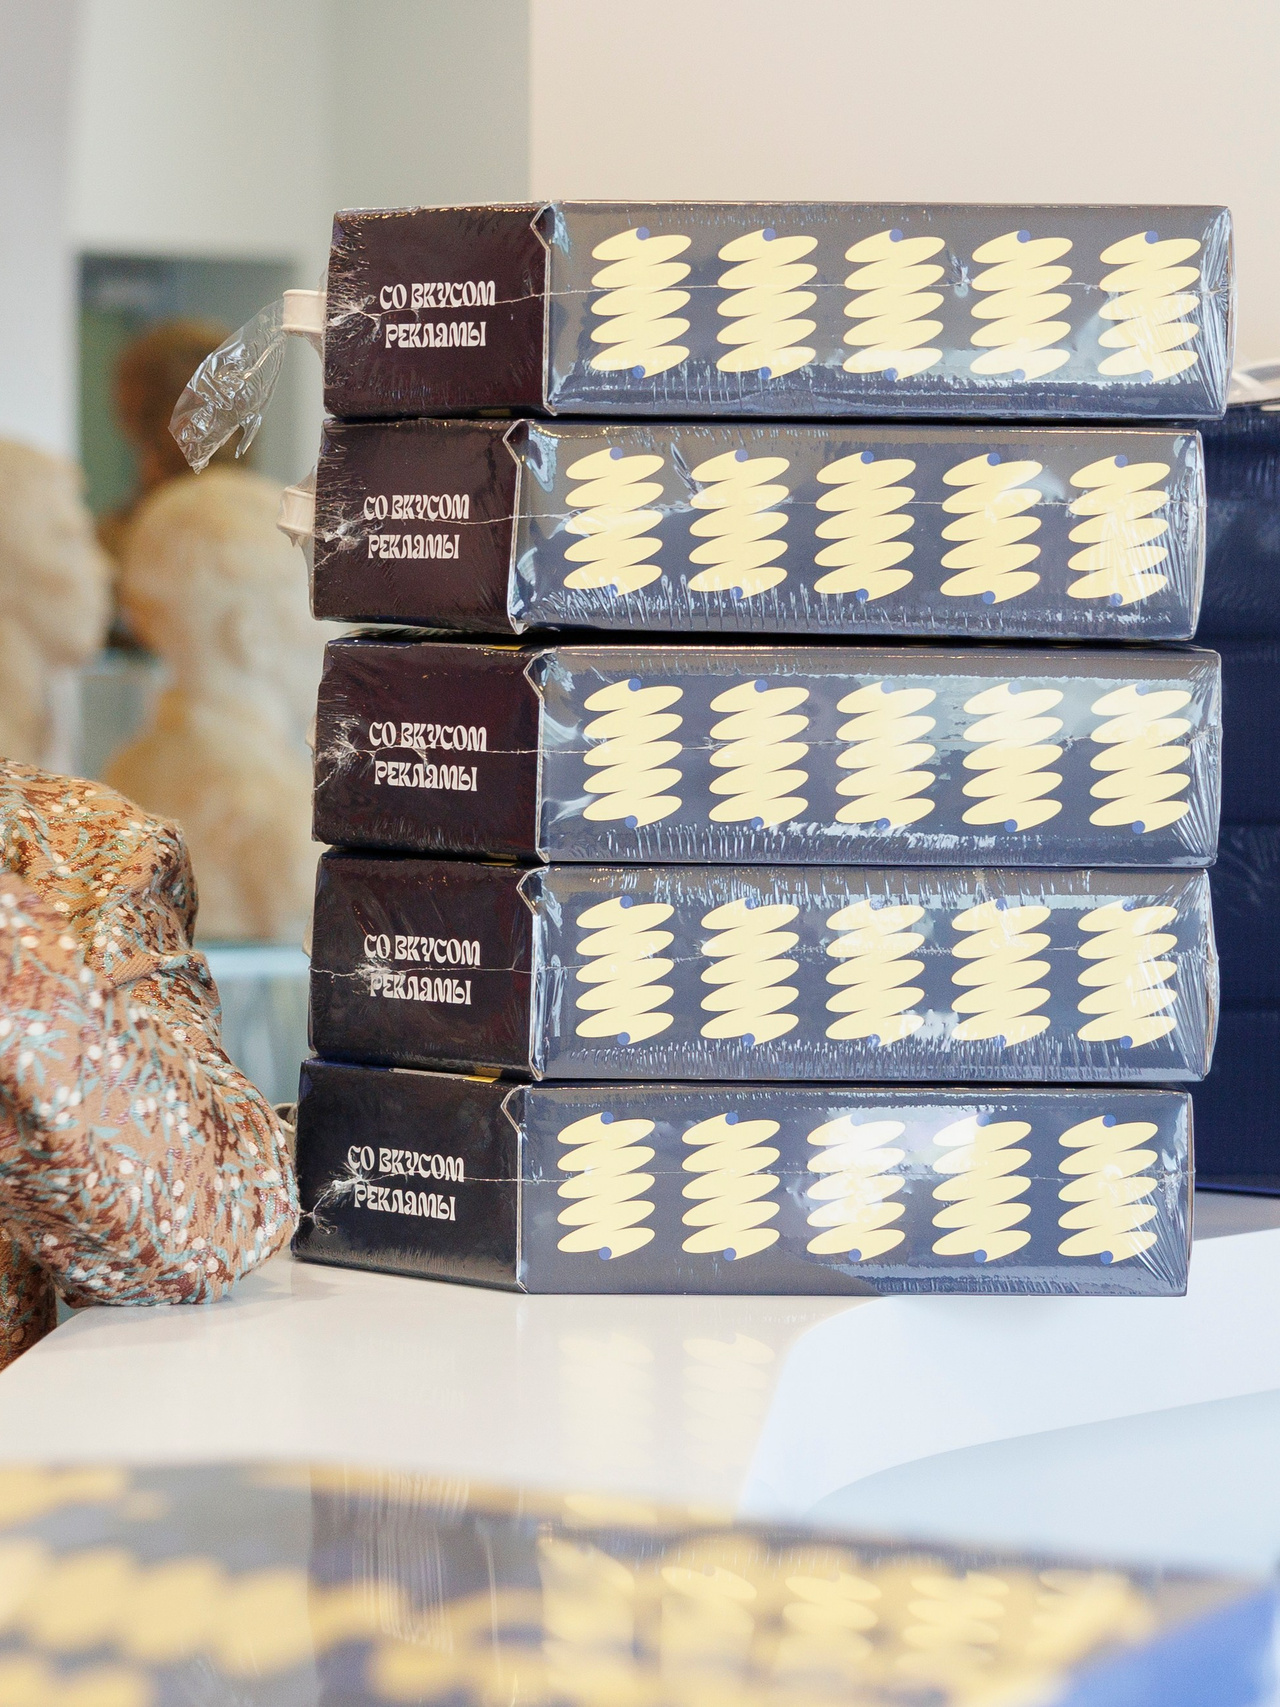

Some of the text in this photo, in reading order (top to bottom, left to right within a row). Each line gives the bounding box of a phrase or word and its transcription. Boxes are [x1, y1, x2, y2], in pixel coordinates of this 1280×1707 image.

[380, 280, 496, 310] СО ВКУСОМ
[385, 321, 486, 348] РЕКЛАМЫ
[363, 494, 470, 520] СО ВКУСОМ
[368, 533, 460, 559] РЕКЛАМЫ
[369, 721, 487, 751] СО ВКУСОМ
[374, 760, 478, 792] РЕКЛАМЫ
[363, 934, 481, 966] СО ВКУСОМ
[370, 973, 472, 1005] РЕКЛАМЫ
[347, 1145, 465, 1183] СО ВКУСОМ
[354, 1184, 456, 1221] РЕКЛАМЫ
